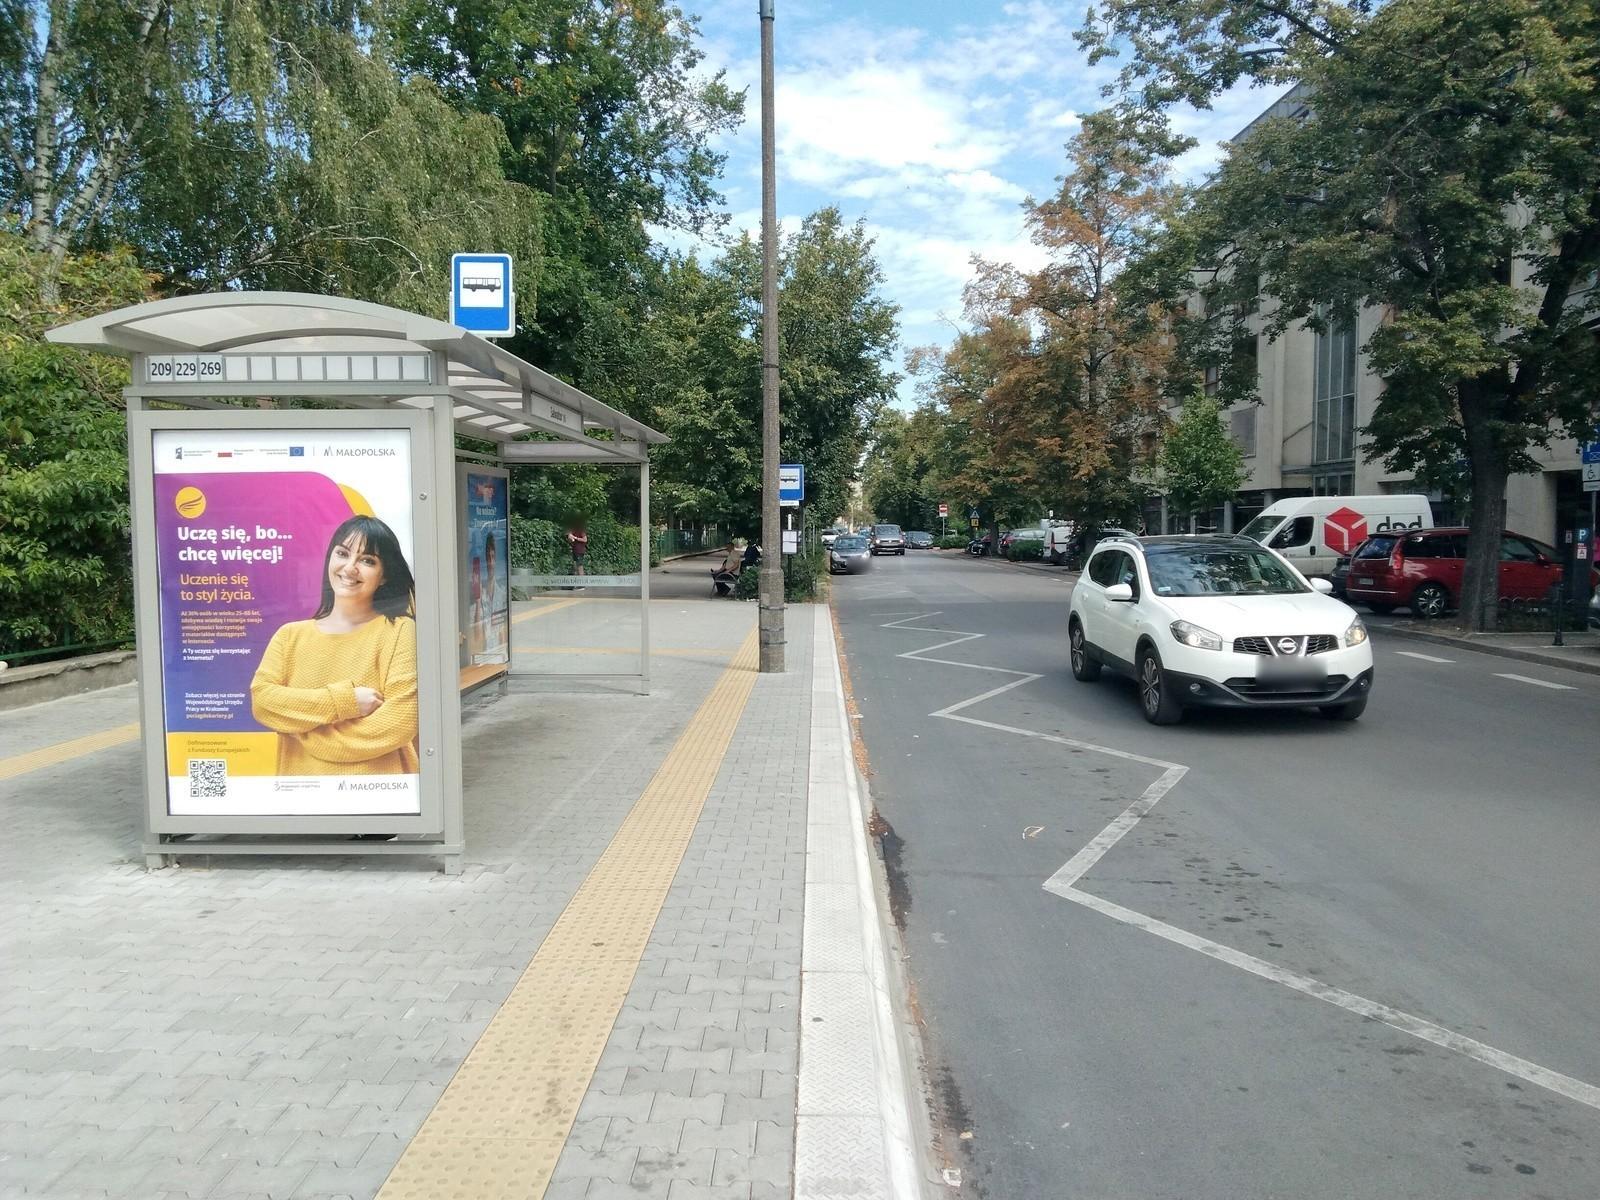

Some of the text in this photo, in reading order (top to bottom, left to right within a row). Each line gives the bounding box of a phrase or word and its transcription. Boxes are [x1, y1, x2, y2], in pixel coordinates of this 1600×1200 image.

[151, 362, 172, 376] 209
[175, 362, 196, 376] 229
[200, 361, 221, 376] 269
[336, 447, 395, 457] MAŁOPOLSKA
[177, 525, 293, 544] Uczę się, bo...
[178, 546, 283, 564] chcę więcej!
[180, 574, 249, 588] Uczenie się
[180, 588, 255, 604] to styl życia.
[350, 781, 409, 791] MAŁOPOLSKA
